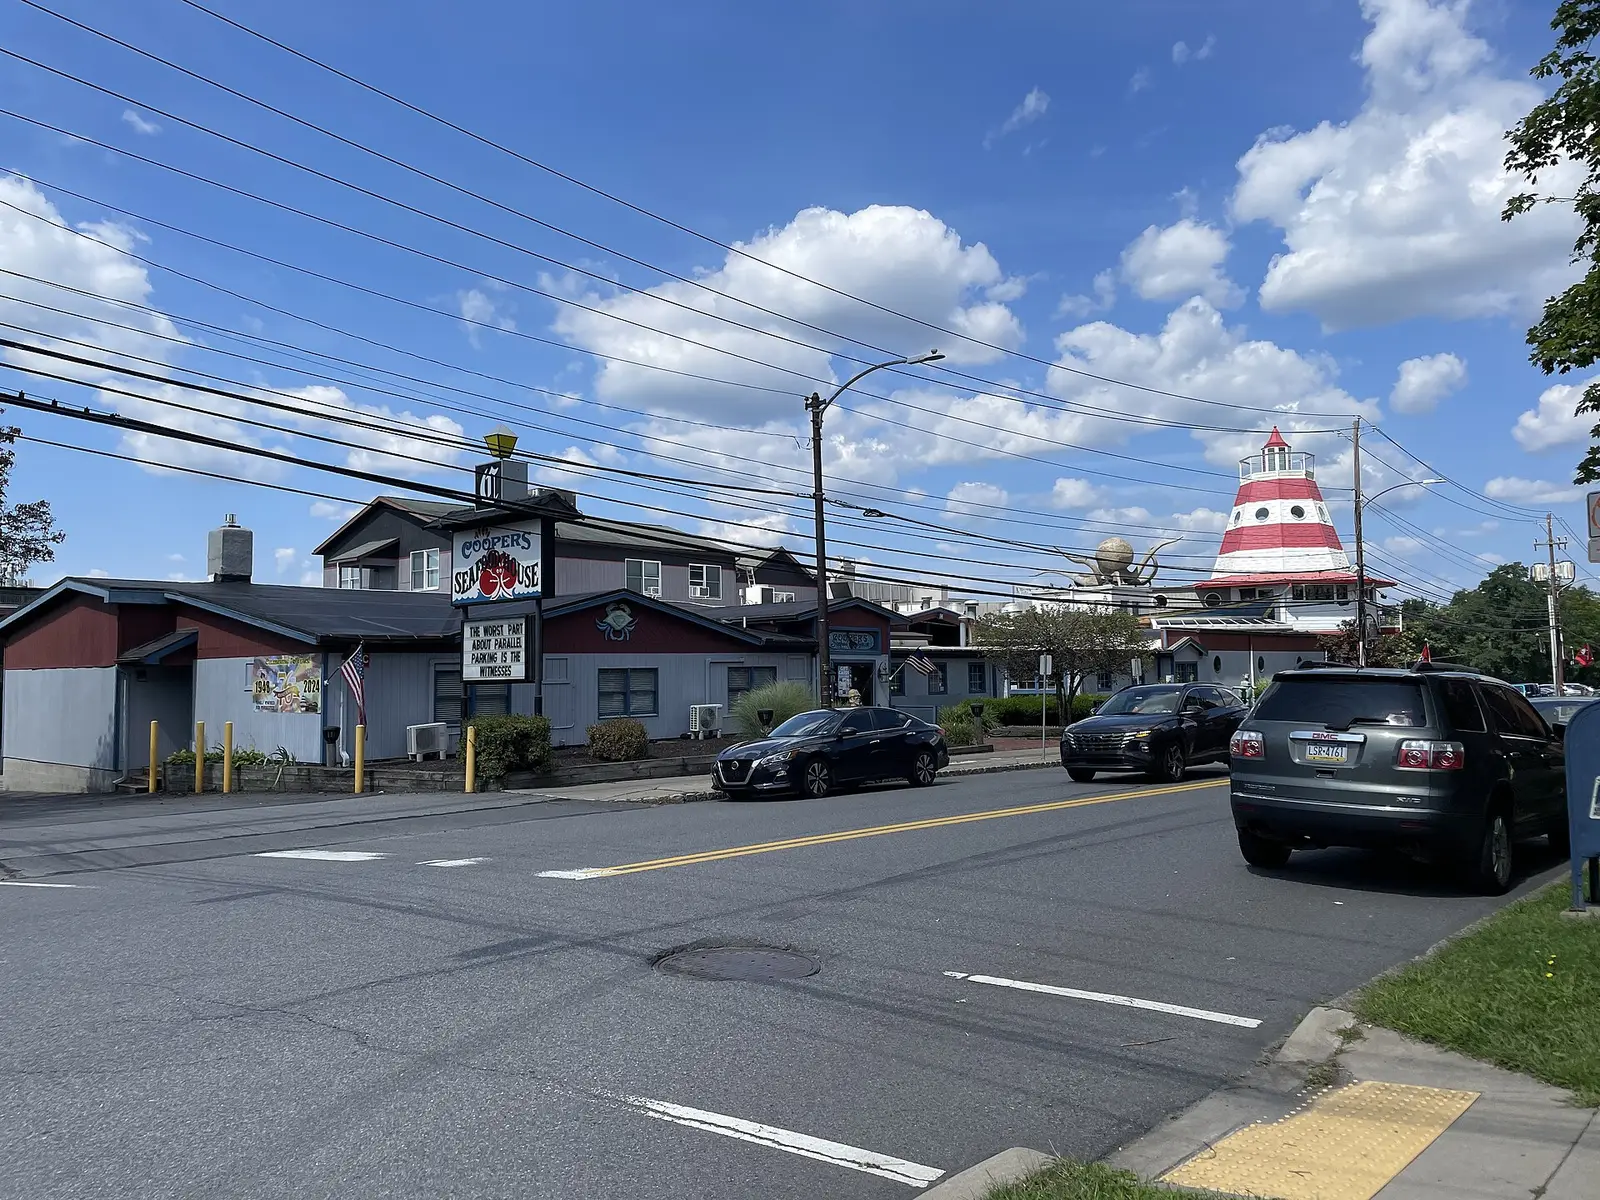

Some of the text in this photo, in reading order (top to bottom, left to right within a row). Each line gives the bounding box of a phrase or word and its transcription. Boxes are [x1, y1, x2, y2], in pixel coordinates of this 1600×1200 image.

[461, 532, 532, 559] COOPERS
[502, 552, 539, 588] HOUSE
[470, 623, 523, 638] THE WORST PART
[472, 637, 522, 650] ABOUT PARALLEL
[471, 651, 520, 664] PARKING IS THE
[480, 665, 512, 677] WITNESSES
[254, 680, 270, 694] 1948
[304, 680, 320, 694] 2024
